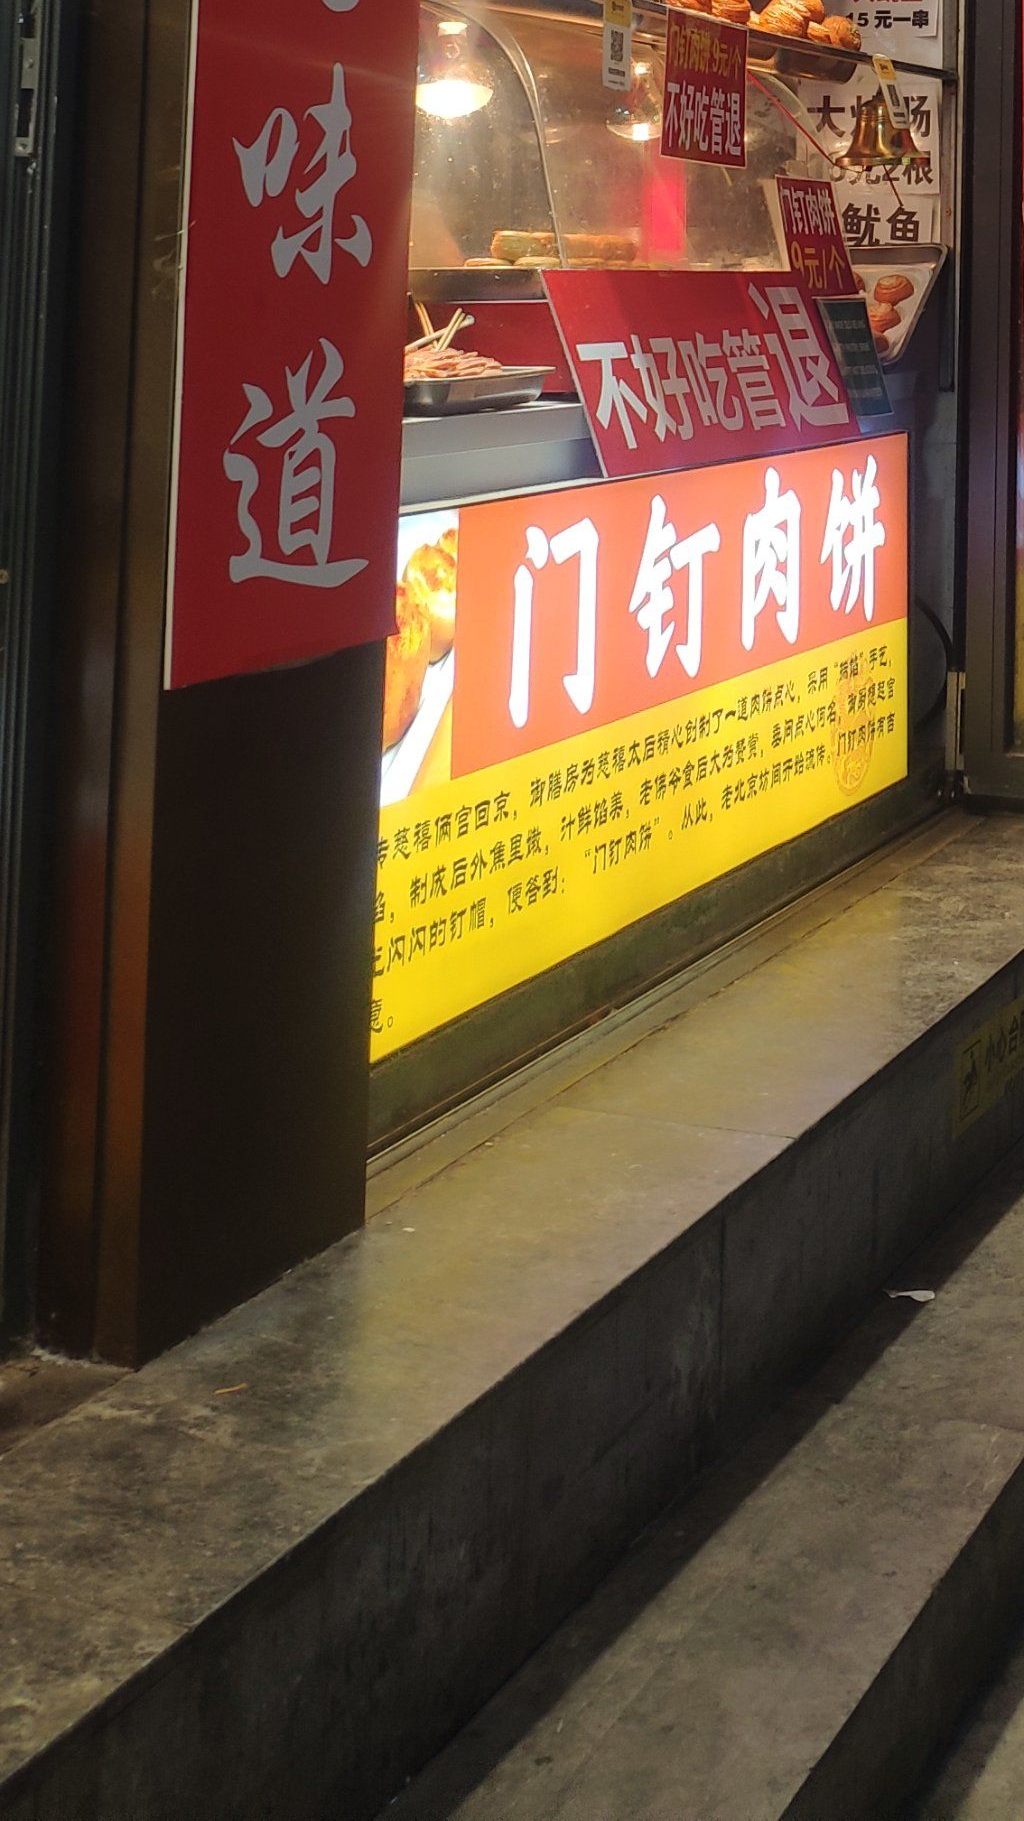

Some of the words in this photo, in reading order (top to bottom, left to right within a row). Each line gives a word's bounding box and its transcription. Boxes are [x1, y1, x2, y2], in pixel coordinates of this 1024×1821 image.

[665, 80, 741, 156] 不好吃管退
[780, 187, 837, 236] 门钉肉饼
[576, 284, 850, 450] 不好吃管退
[507, 454, 885, 729] 门钉肉饼
